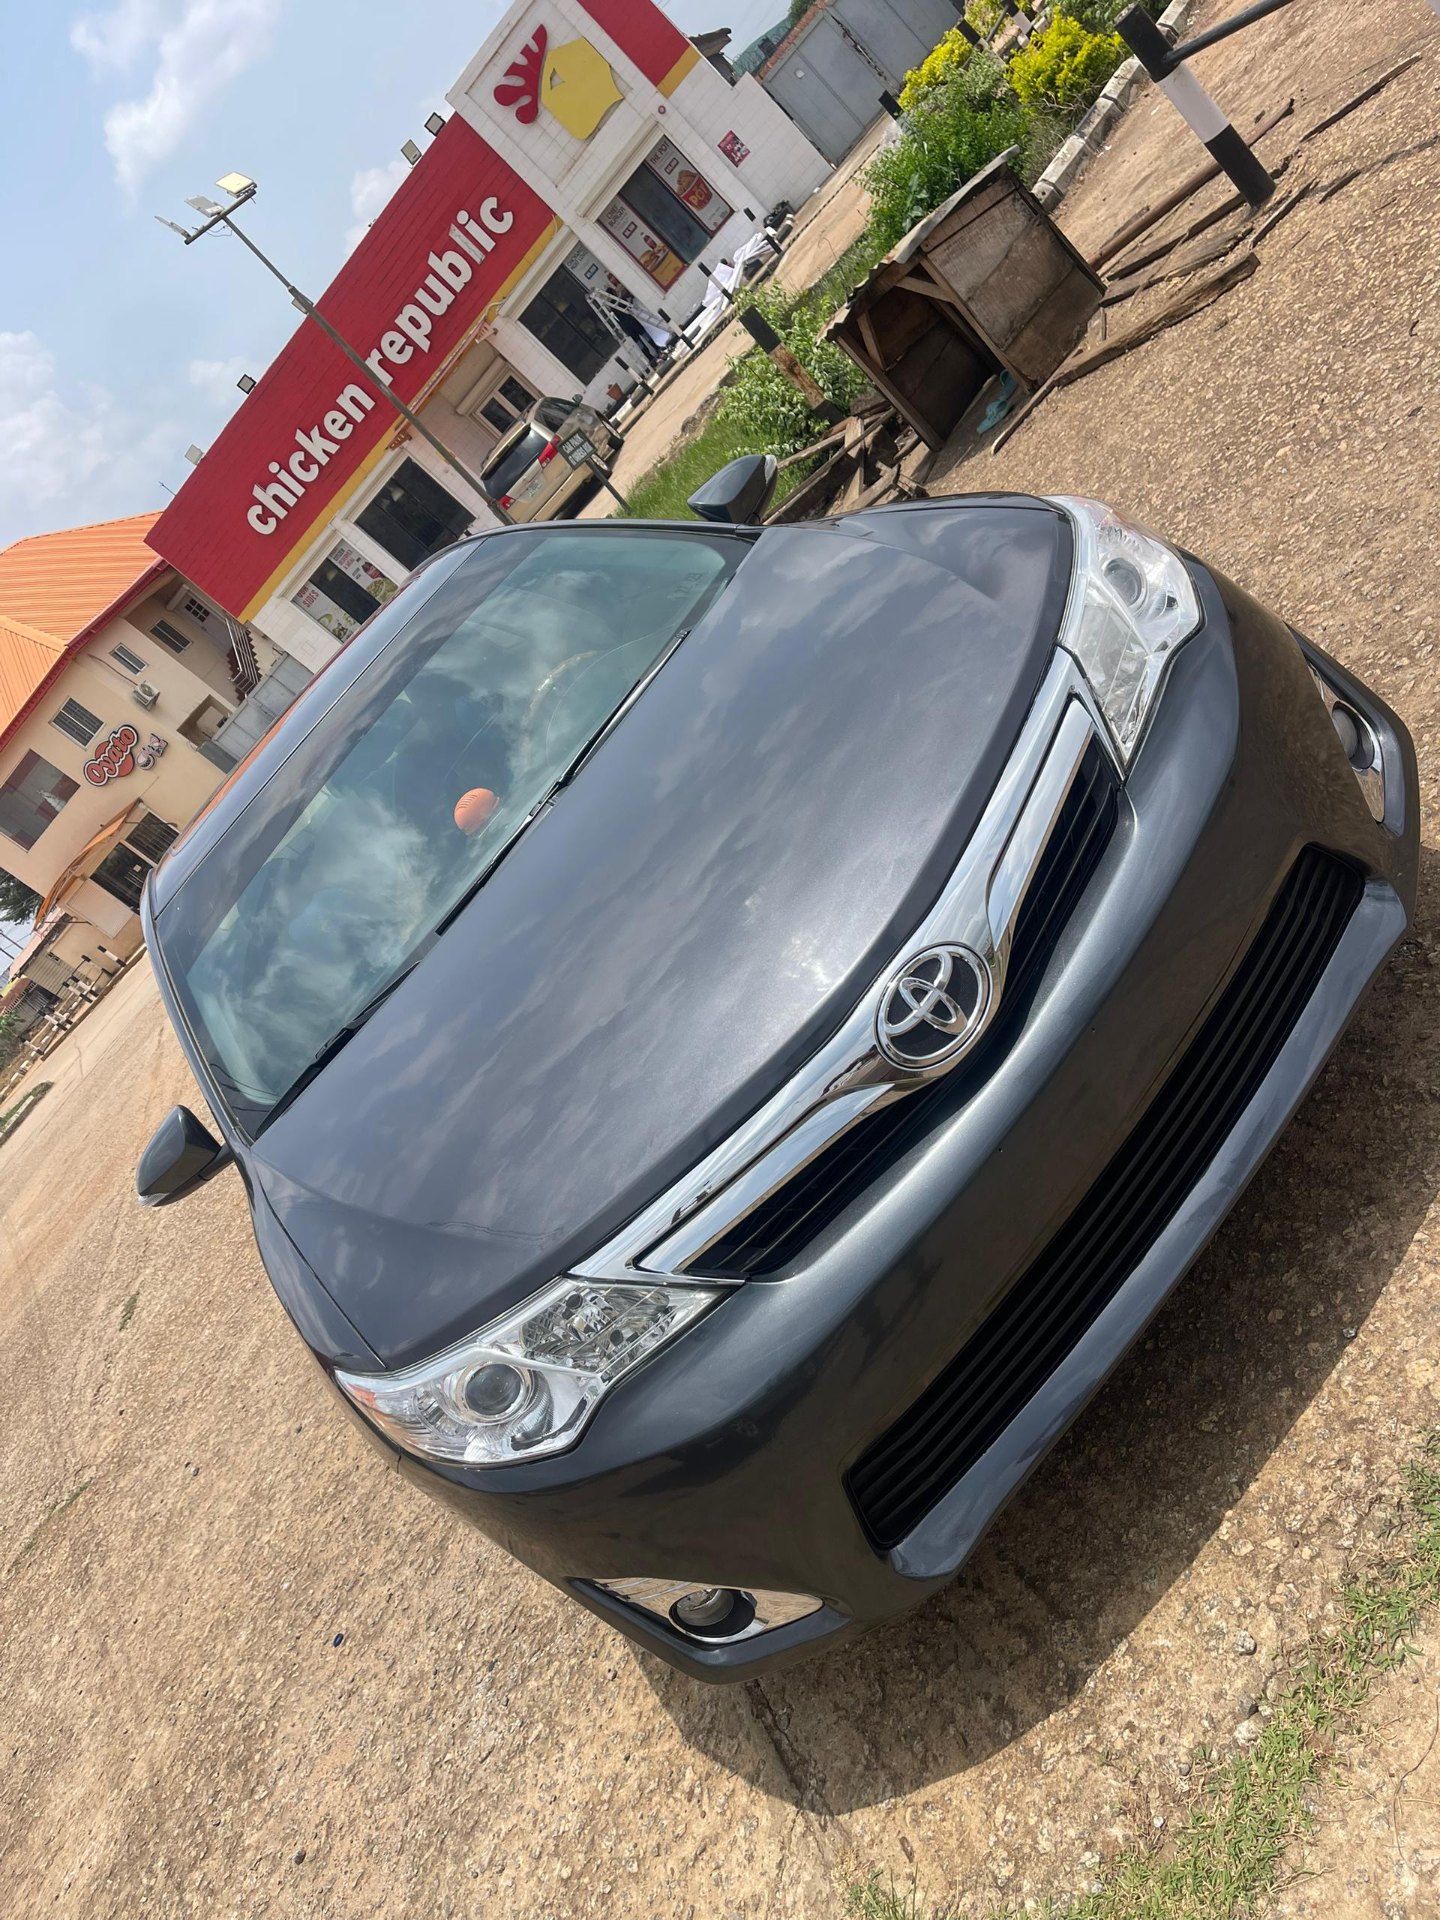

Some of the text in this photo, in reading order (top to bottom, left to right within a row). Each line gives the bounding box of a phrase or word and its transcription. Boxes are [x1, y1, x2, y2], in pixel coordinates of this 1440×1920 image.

[650, 152, 661, 164] THE
[658, 141, 670, 154] POT
[689, 183, 709, 206] POT
[247, 196, 514, 535] chicken republic
[302, 590, 319, 608] SIDES
[85, 726, 136, 785] Oyato
